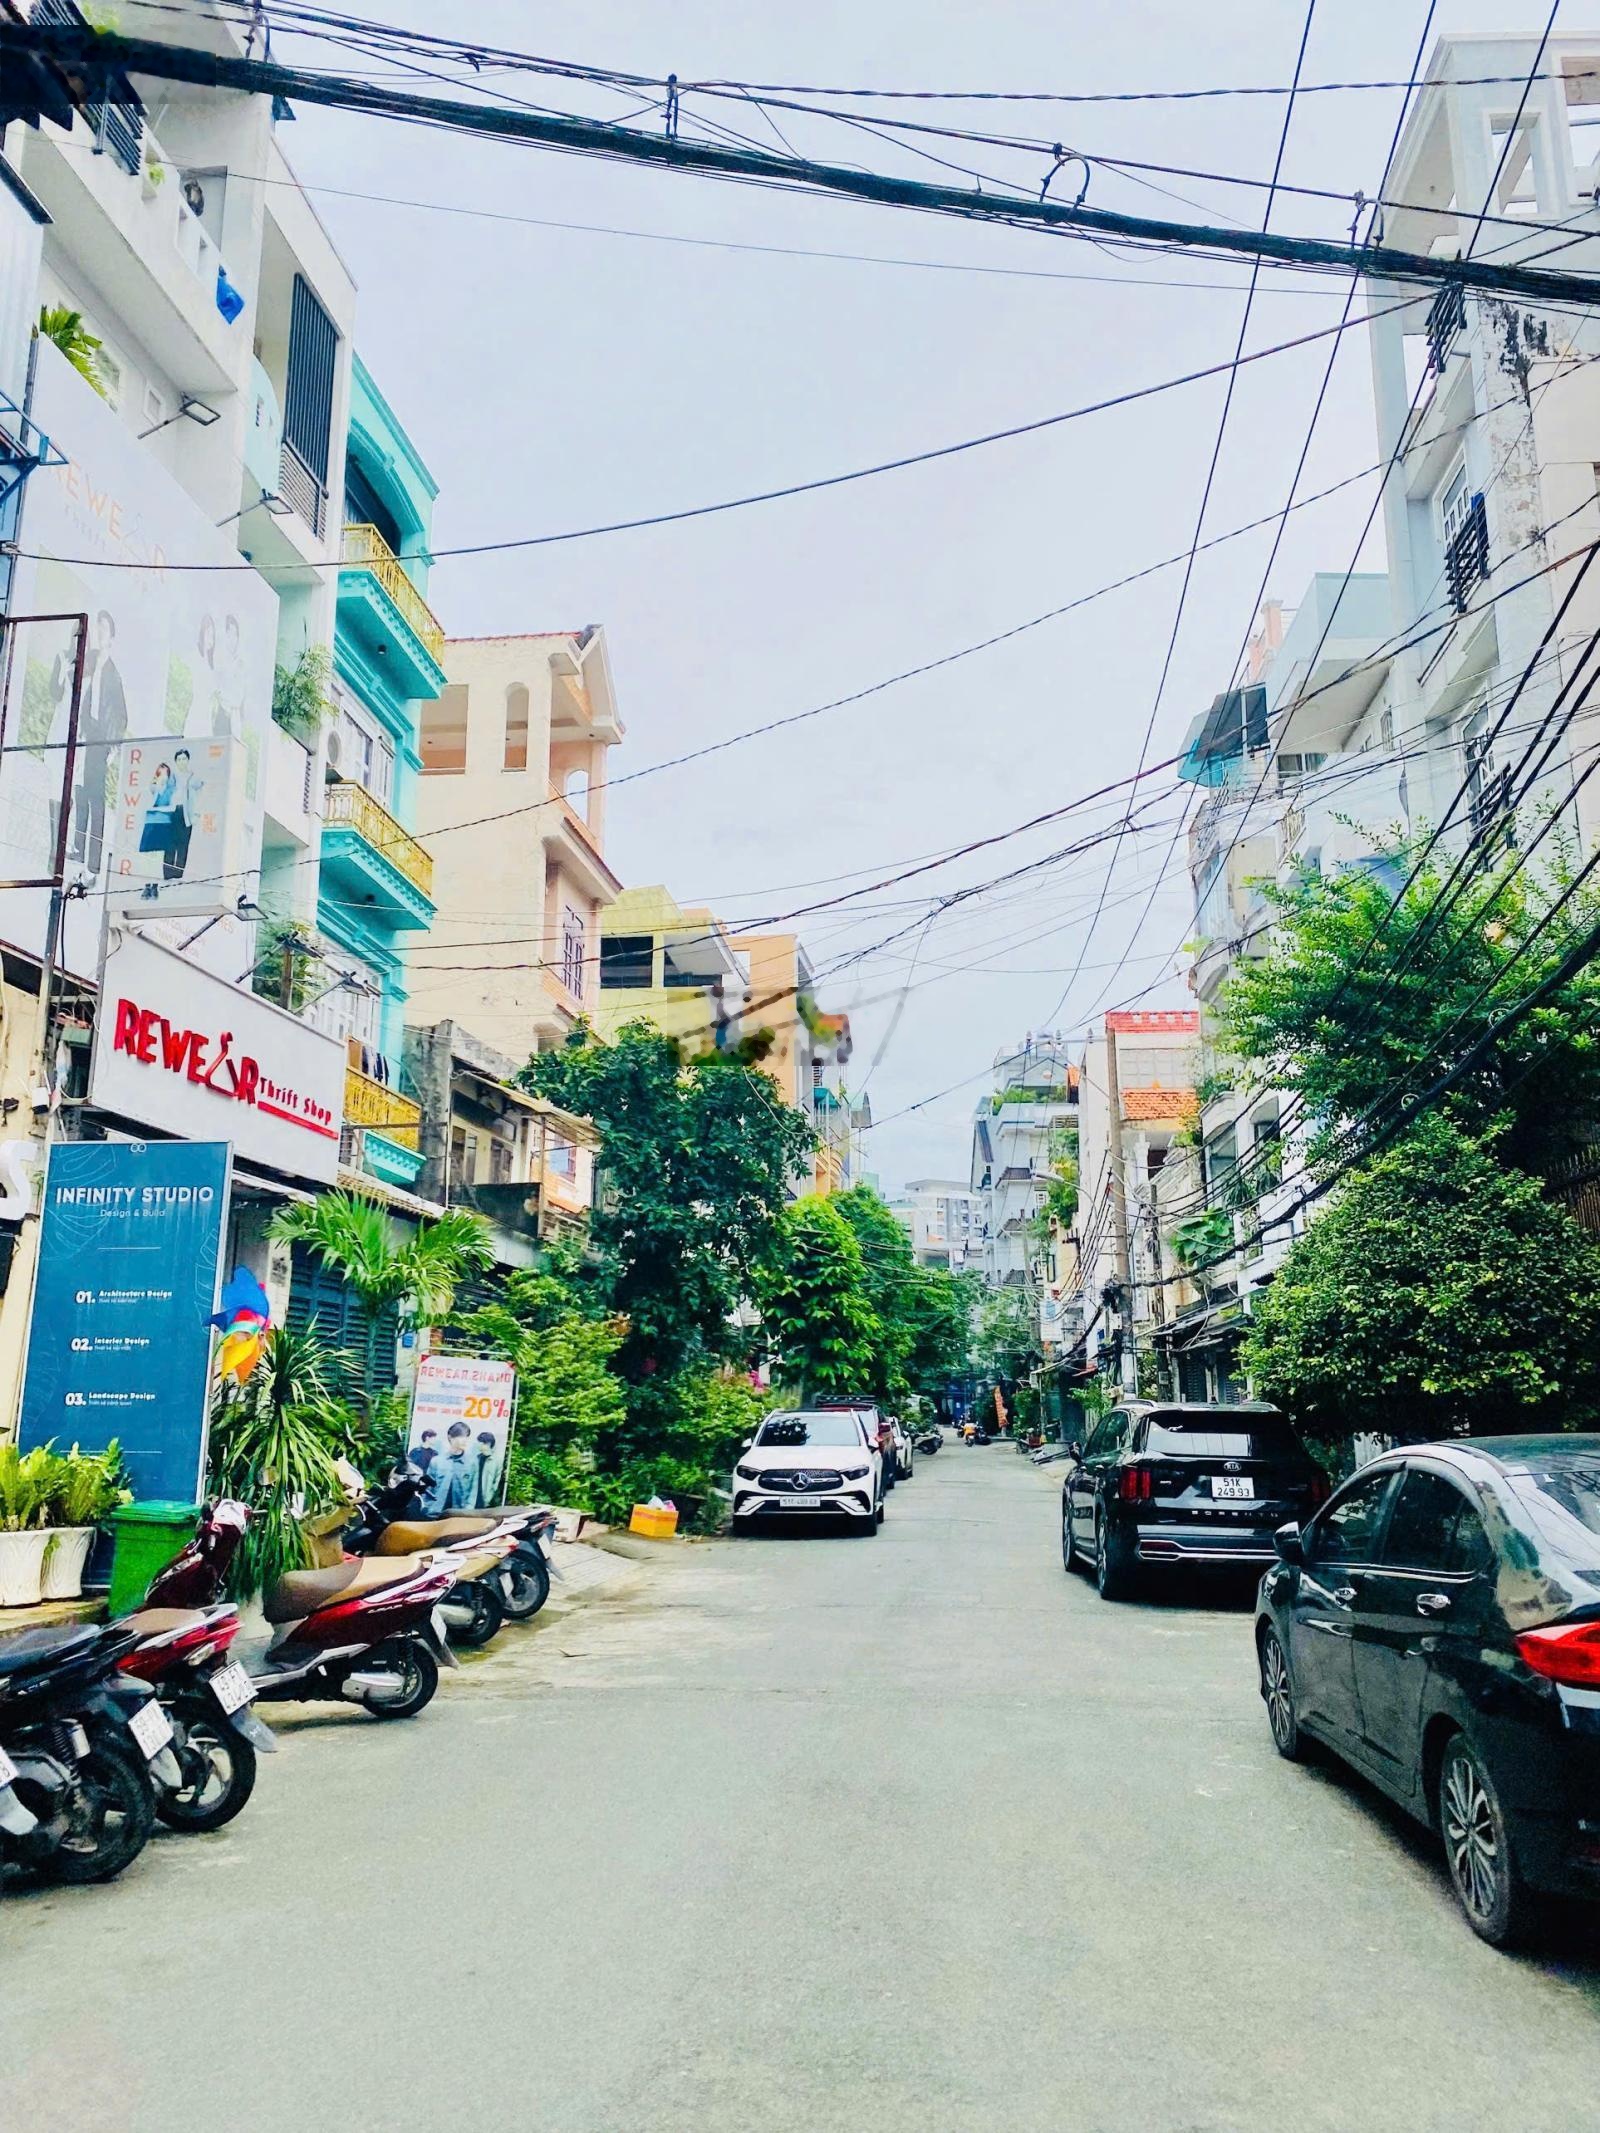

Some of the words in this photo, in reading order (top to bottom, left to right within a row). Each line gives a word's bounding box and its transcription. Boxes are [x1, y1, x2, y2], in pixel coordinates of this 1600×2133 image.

[113, 998, 259, 1104] REWEAR
[260, 1076, 299, 1109] Thrift
[303, 1097, 332, 1126] Shop
[56, 1186, 136, 1204] INFINITY
[141, 1185, 215, 1204] STUDIO
[100, 1209, 131, 1219] Design
[133, 1209, 140, 1217] &
[142, 1208, 165, 1217] Build
[76, 1290, 96, 1304] 01.
[146, 1289, 172, 1298] Design
[71, 1337, 94, 1351] 02.
[94, 1337, 123, 1345] Interior
[124, 1337, 150, 1346] Design
[420, 1366, 469, 1380] REWEAR
[65, 1392, 87, 1406] 03.
[89, 1392, 128, 1400] Landscape
[130, 1392, 156, 1401] Design
[1224, 1462, 1241, 1471] KIA
[1223, 1477, 1241, 1487] 51K
[1217, 1487, 1250, 1497] 249.93
